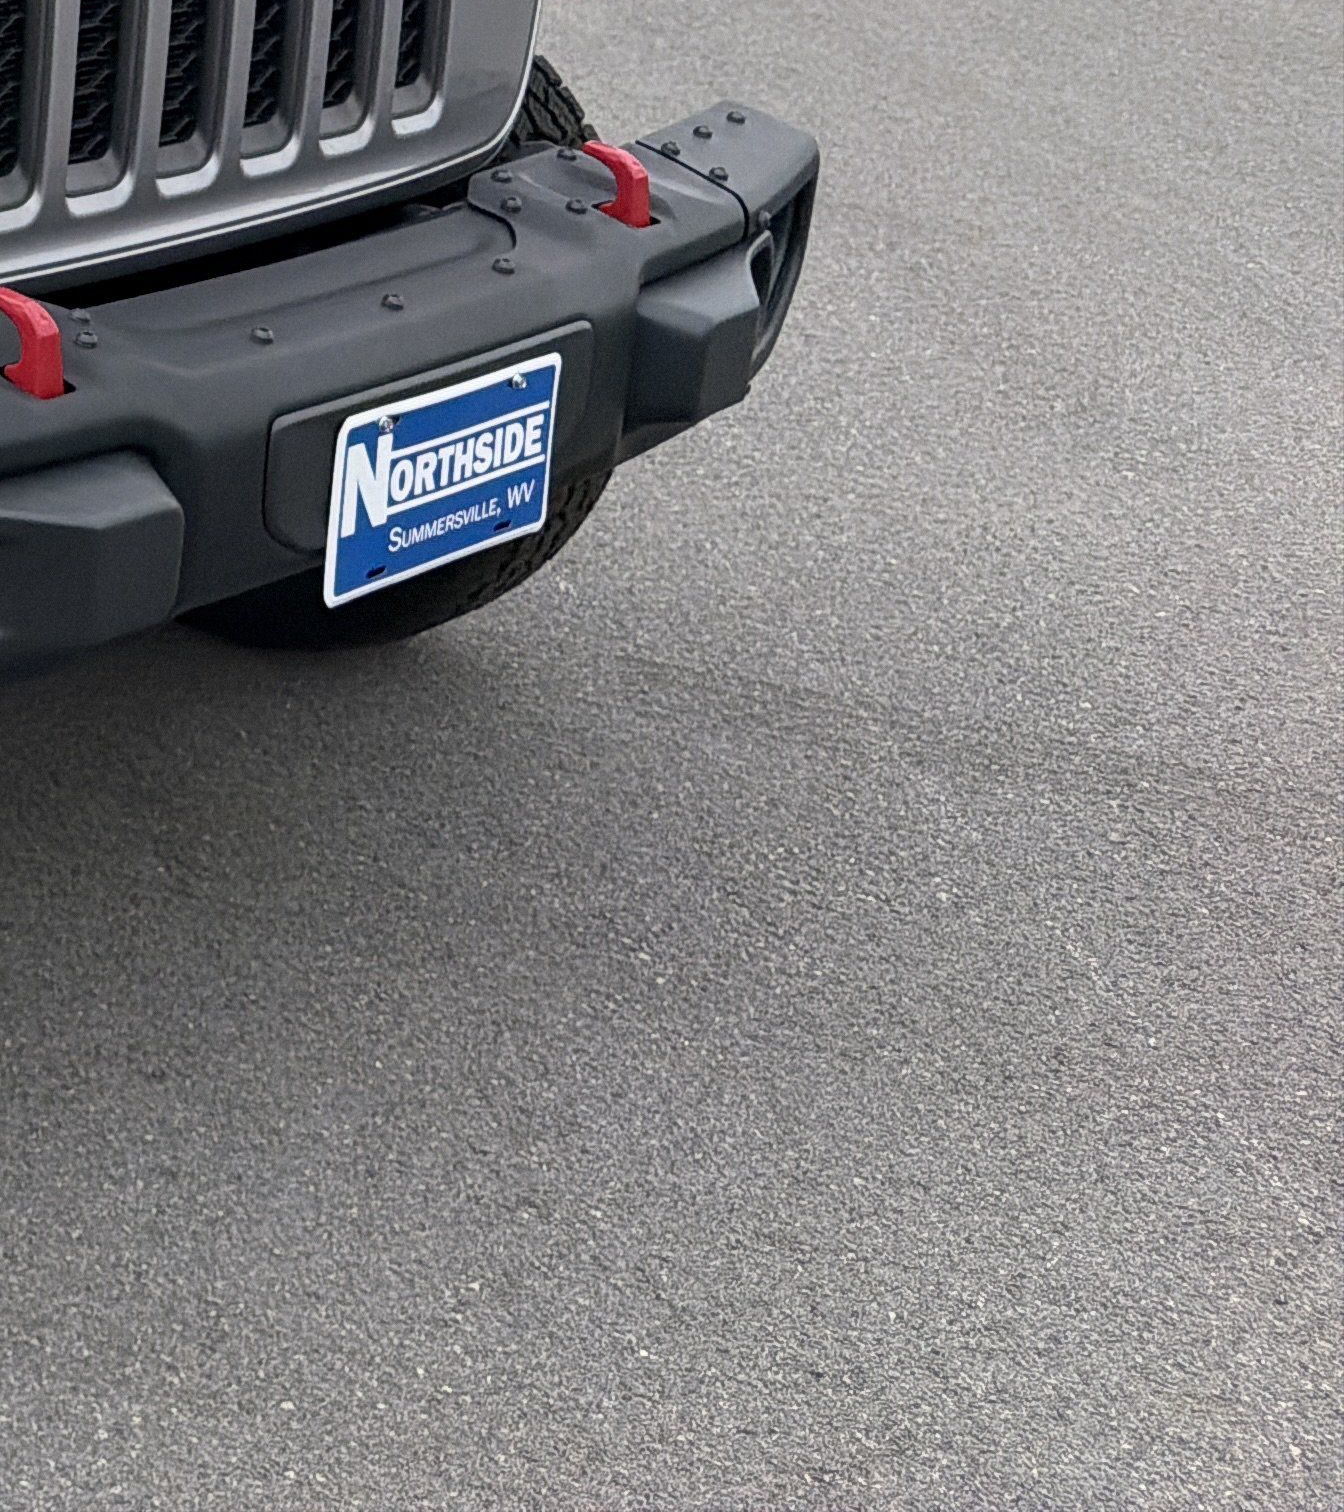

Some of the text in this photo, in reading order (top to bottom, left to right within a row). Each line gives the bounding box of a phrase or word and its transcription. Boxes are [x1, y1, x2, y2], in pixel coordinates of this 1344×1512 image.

[340, 413, 545, 538] NORTHSIDE
[388, 478, 536, 553] SUMMERSVILLE, WV
